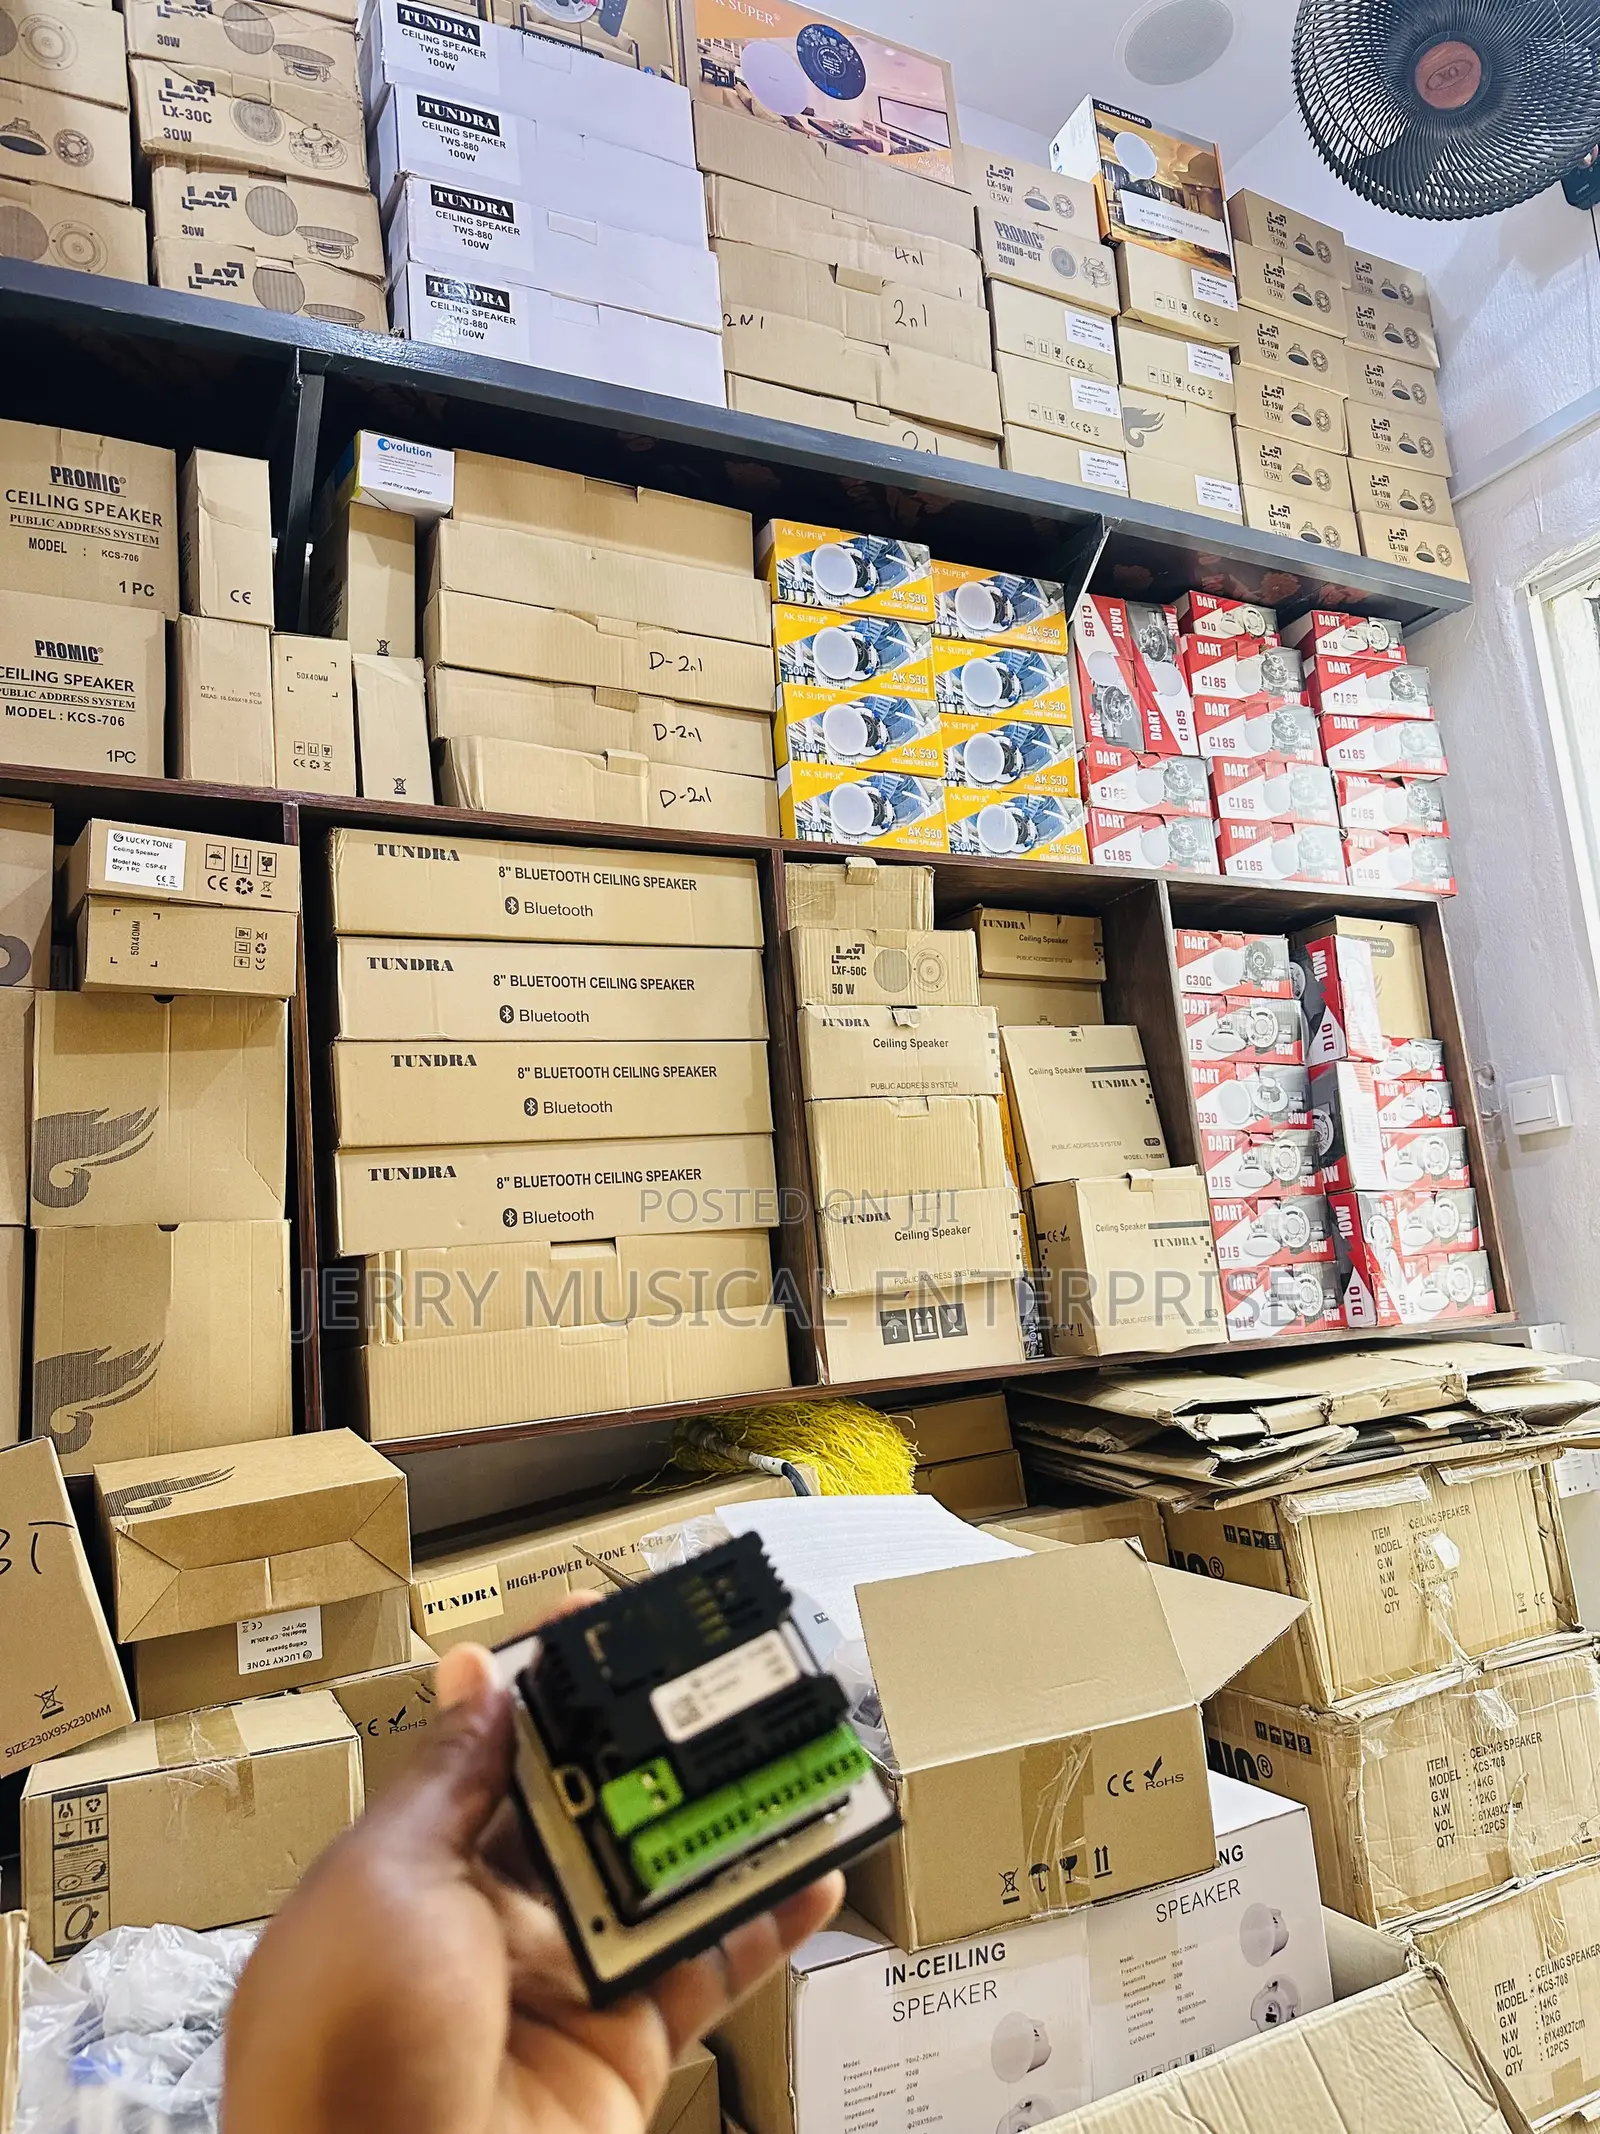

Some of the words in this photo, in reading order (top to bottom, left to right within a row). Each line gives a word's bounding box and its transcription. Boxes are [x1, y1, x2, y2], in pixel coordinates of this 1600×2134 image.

[401, 8, 477, 42] TUNDRA
[157, 34, 180, 48] 30W
[401, 28, 440, 46] CEILING
[442, 40, 487, 60] SPEAKER
[418, 43, 459, 62] TWS-880
[427, 57, 456, 72] 100W
[162, 104, 213, 124] LX-30C
[420, 100, 497, 132] TUNDRA
[1099, 103, 1120, 116] CEILING
[1122, 109, 1146, 125] SPEAKER
[163, 127, 192, 143] 30W
[422, 120, 461, 137] CEILING
[462, 131, 506, 149] SPEAKER
[439, 135, 479, 153] TWS-880
[448, 148, 476, 163] 100W
[986, 178, 1013, 193] LX-15W
[434, 189, 510, 220] TUNDRA
[182, 224, 204, 237] 30W
[435, 210, 473, 227] CEILING
[475, 219, 521, 236] SPEAKER
[452, 225, 493, 242] TWS-880
[461, 238, 490, 251] 100W
[998, 254, 1015, 266] 30W
[1262, 399, 1283, 411] LX-15W
[377, 437, 432, 459] evolution
[1261, 459, 1282, 471] LX-15W
[5, 490, 79, 511] CEILING
[84, 500, 163, 527] SPEAKER
[10, 514, 55, 528] PUBLIC
[57, 520, 110, 536] ADDRESS
[113, 528, 159, 546] SYSTEM
[1269, 519, 1290, 530] LX-15W
[101, 549, 139, 563] KCS-706
[891, 590, 907, 602] AK
[909, 592, 928, 604] S30
[1196, 595, 1217, 610] DART
[1082, 606, 1095, 637] C185
[1109, 607, 1124, 639] DART
[1201, 621, 1216, 632] D10
[1318, 614, 1340, 627] DART
[1197, 641, 1222, 657] DART
[1322, 639, 1338, 650] D10
[64, 673, 135, 692] SPEAKER
[1201, 675, 1227, 689] C185
[39, 692, 89, 704] ADDRESS
[91, 697, 135, 709] SYSTEM
[67, 711, 125, 726] KCS-706
[1204, 703, 1230, 718] DART
[1150, 709, 1163, 741] DART
[1176, 709, 1189, 741] C185
[1209, 736, 1236, 749] C185
[106, 750, 136, 763] 1PC
[902, 747, 917, 758] AK
[919, 748, 938, 760] S30
[1099, 813, 1125, 828] DART
[907, 827, 922, 838] AK
[924, 828, 943, 840] S30
[126, 836, 151, 846] LUCKY
[152, 839, 174, 850] TONE
[113, 845, 135, 855] Ceiling
[136, 848, 160, 858] Speaker
[374, 843, 460, 862] TUNDRA
[1104, 849, 1132, 862] C185
[514, 867, 591, 885] BLUETOOTH
[592, 873, 641, 888] CEILING
[643, 876, 697, 892] SPEAKER
[524, 900, 593, 918] Bluetooth
[131, 920, 141, 956] 50X40MM
[1183, 936, 1210, 950] DART
[367, 956, 454, 972] TUNDRA
[831, 964, 867, 977] LXF-50C
[510, 975, 587, 989] BLUETOOTH
[589, 976, 638, 990] CEILING
[640, 977, 695, 991] SPEAKER
[1260, 980, 1280, 993] 30W
[519, 1008, 590, 1024] Bluetooth
[820, 1018, 870, 1028] TUNDRA
[873, 1037, 907, 1050] Ceiling
[910, 1038, 949, 1051] Speaker
[391, 1054, 477, 1068] TUNDRA
[534, 1066, 610, 1079] BLUETOOTH
[612, 1066, 660, 1079] CEILING
[663, 1065, 717, 1078] SPEAKER
[870, 1082, 896, 1090] PUBLIC
[897, 1081, 929, 1090] ADDRESS
[930, 1081, 958, 1090] SYSTEM
[543, 1100, 613, 1115] Bluetooth
[1207, 1135, 1236, 1151] DART
[368, 1165, 457, 1181] TUNDRA
[513, 1173, 592, 1188] BLUETOOTH
[594, 1170, 643, 1185] CEILING
[645, 1168, 702, 1183] SPEAKER
[1211, 1176, 1231, 1188] D15
[523, 1208, 594, 1224] Bluetooth
[1337, 1206, 1353, 1240] 10W
[894, 1228, 930, 1242] Ceiling
[932, 1224, 971, 1240] Speaker
[1151, 1237, 1197, 1248] TUNDRA
[1350, 1285, 1363, 1317] D10
[1374, 1540, 1403, 1556] MODEL
[507, 1560, 583, 1591] HIGH-POWER
[424, 1585, 498, 1616] TUNDRA
[247, 1658, 267, 1670] TONE
[270, 1651, 301, 1664] LUCKY
[4, 1703, 112, 1759] SIZE:230X95X230MM
[388, 1718, 428, 1735] RoHS
[1426, 1756, 1449, 1772] ITEM
[1144, 1773, 1184, 1791] RoHS
[1428, 1769, 1462, 1788] MODEL
[1473, 1776, 1494, 1790] 14KG
[1155, 1878, 1241, 1923] SPEAKER
[885, 1942, 1006, 1987] IN-CEILING
[1494, 1978, 1516, 1997] ITEM
[1535, 1957, 1565, 1979] CEILING
[1566, 1943, 1600, 1967] SPEAKER
[893, 1979, 998, 2022] SPEAKER
[1496, 1992, 1528, 2013] MODEL
[1539, 1995, 1558, 2012] 14KG
[1541, 2011, 1561, 2027] 12KG
[1503, 2045, 1522, 2061] VOL
[1546, 2040, 1570, 2060] 12PCS
[1505, 2059, 1524, 2077] QTY
